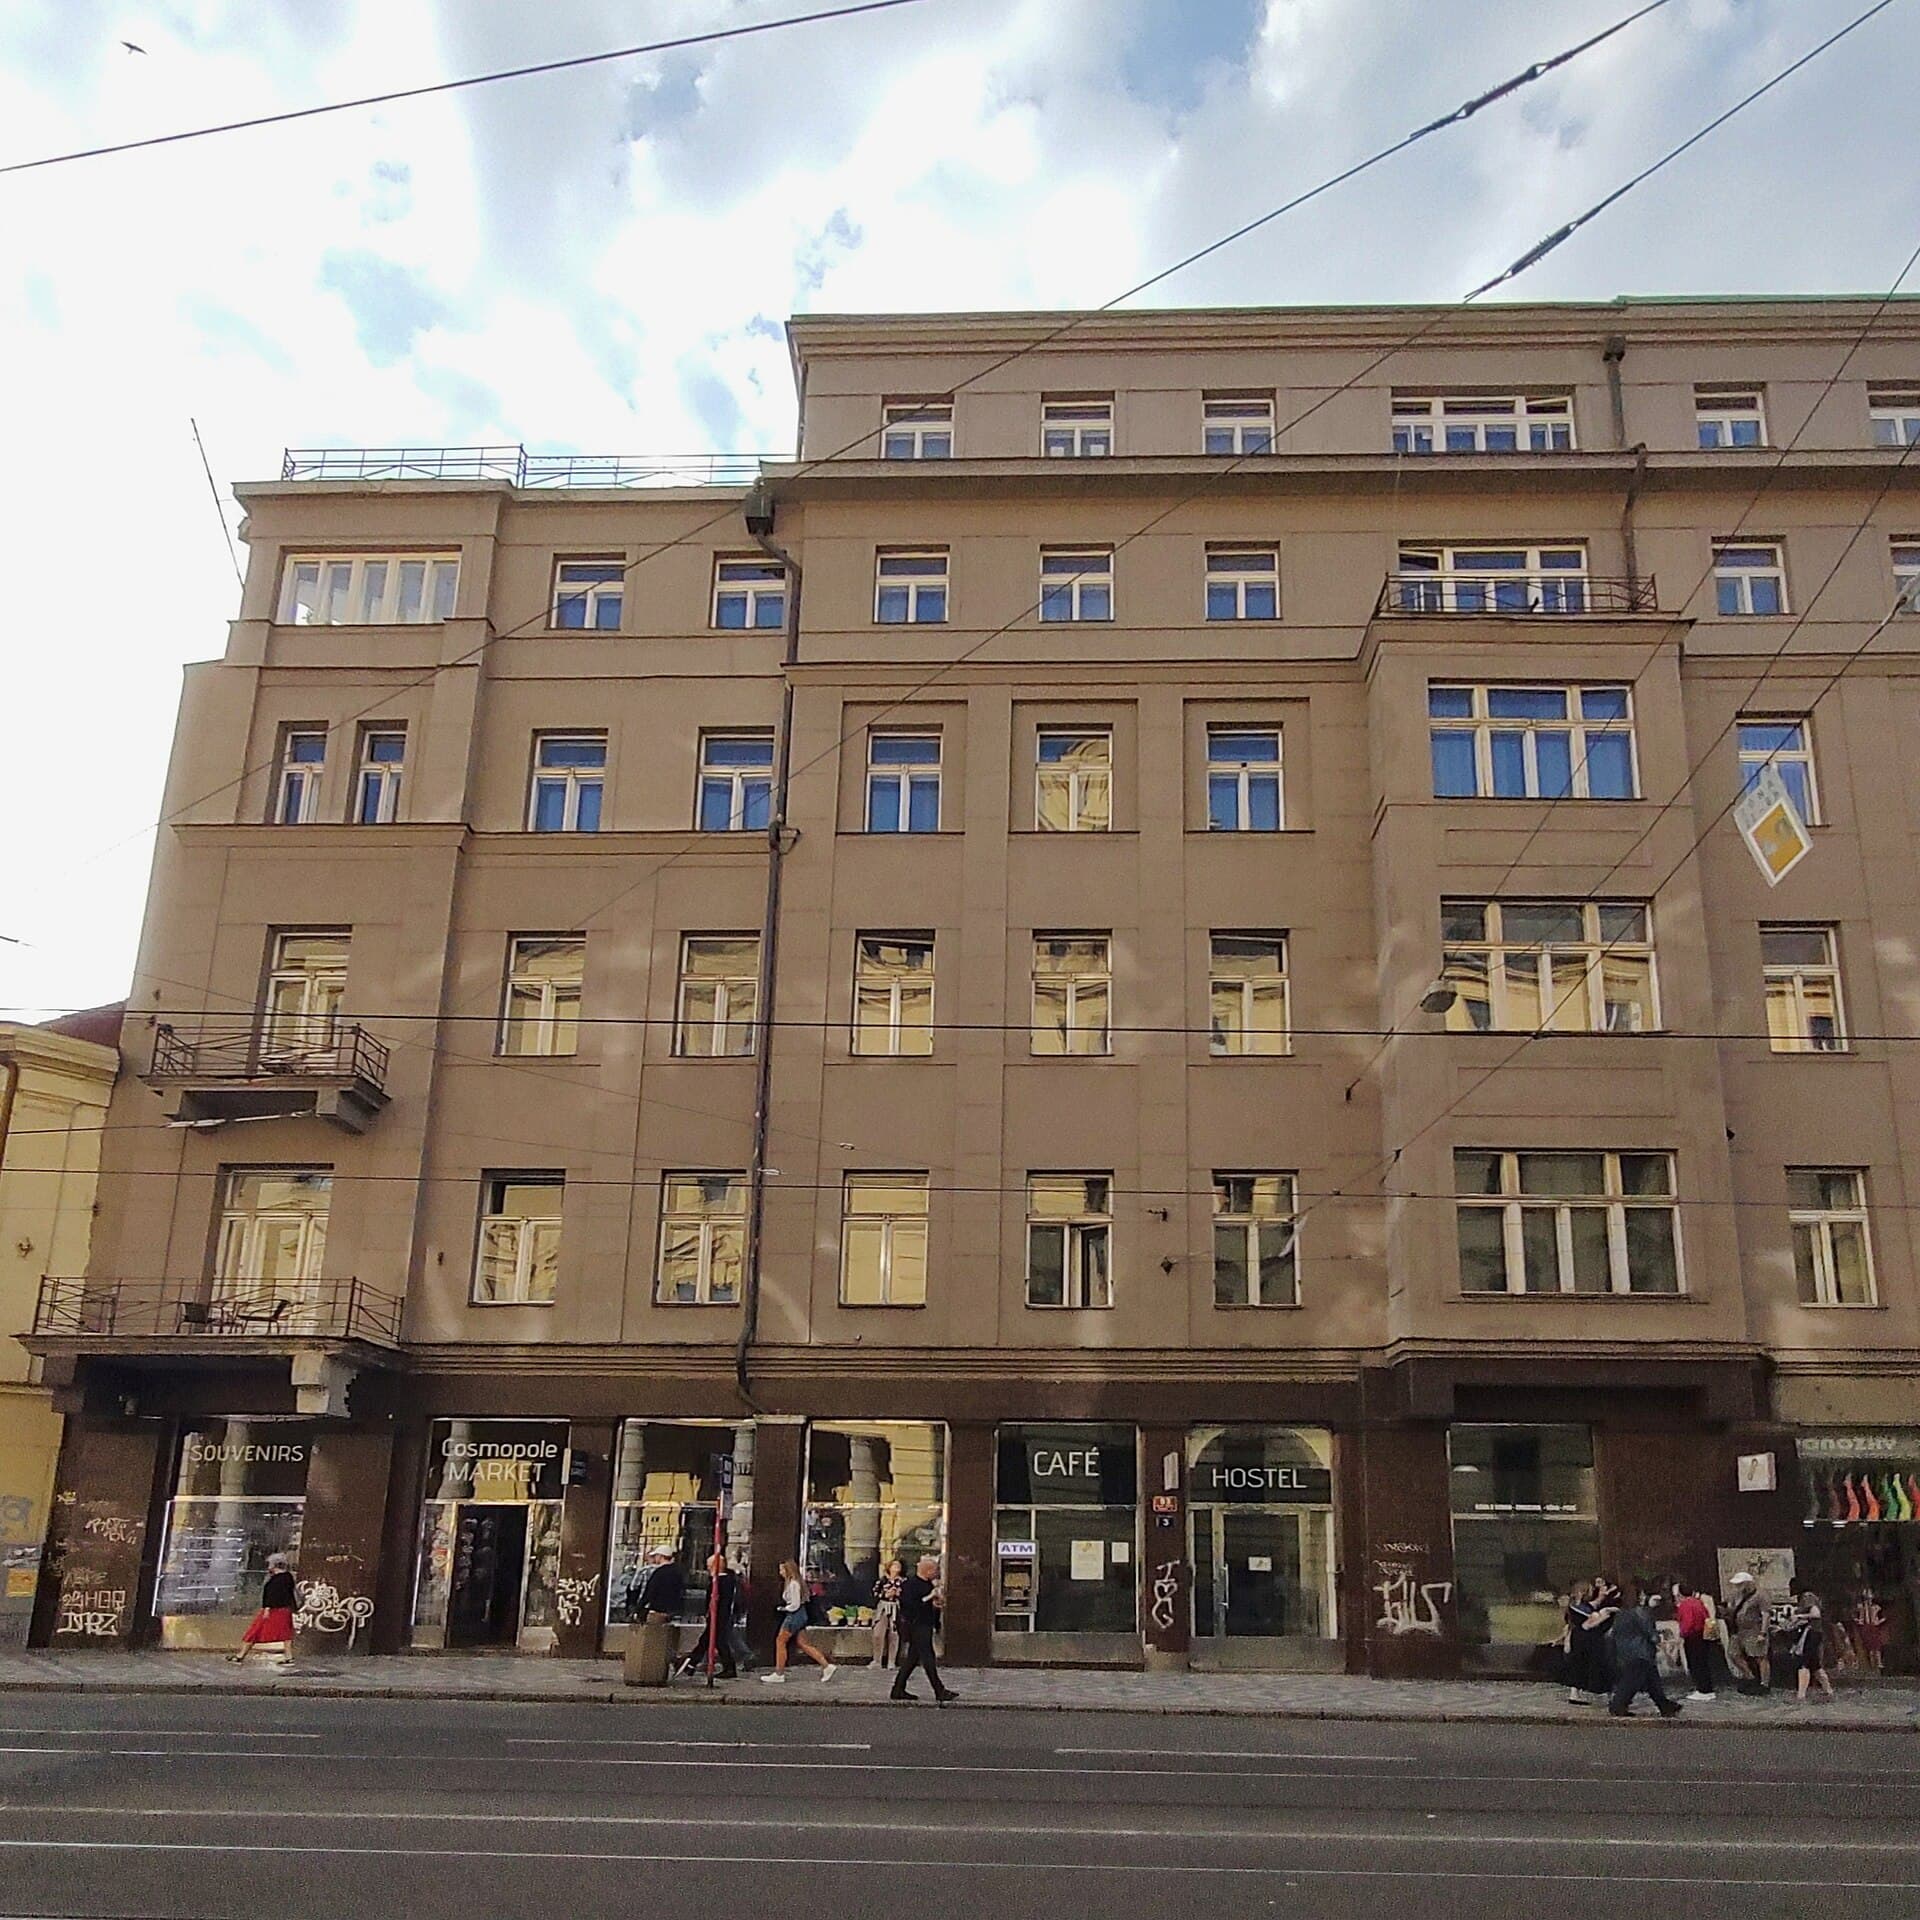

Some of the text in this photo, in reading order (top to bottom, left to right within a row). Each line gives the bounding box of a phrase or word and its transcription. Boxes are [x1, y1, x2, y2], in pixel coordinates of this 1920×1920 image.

[189, 1444, 304, 1462] SOUVENIRS
[442, 1439, 558, 1462] Cosmopole
[448, 1462, 547, 1483] MARKET
[1033, 1447, 1100, 1477] CAFÉ
[1211, 1467, 1309, 1489] HOSTEL
[1000, 1544, 1033, 1553] ATM
